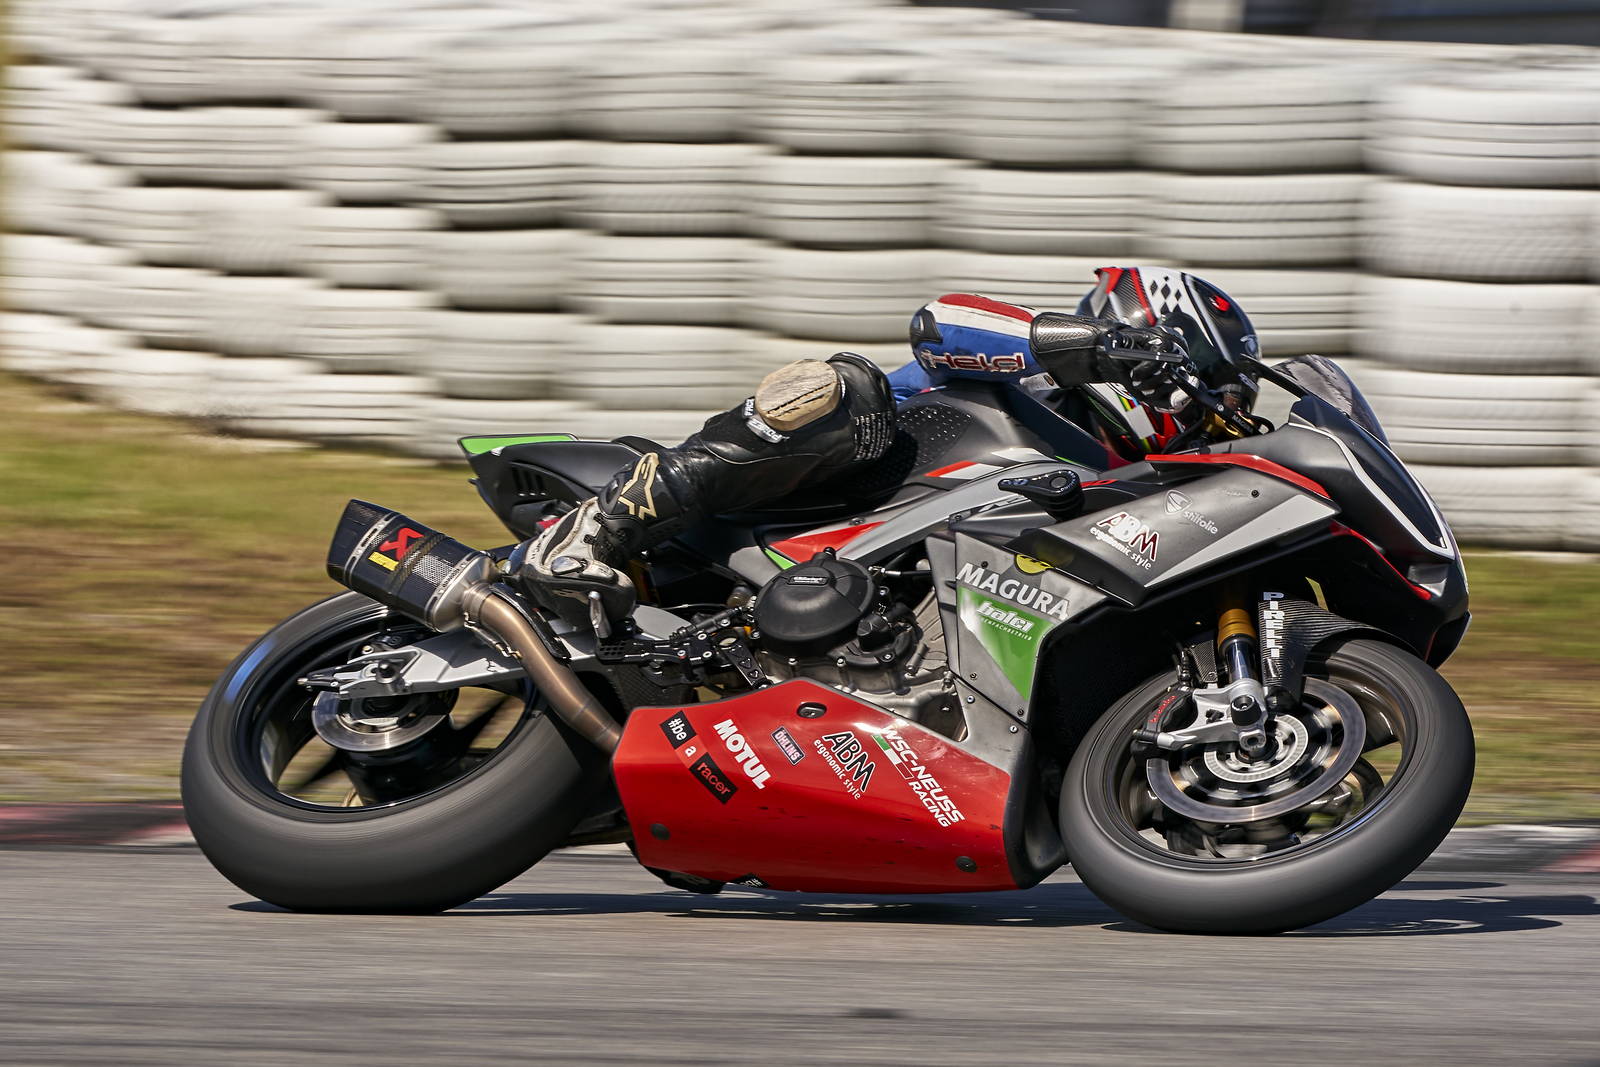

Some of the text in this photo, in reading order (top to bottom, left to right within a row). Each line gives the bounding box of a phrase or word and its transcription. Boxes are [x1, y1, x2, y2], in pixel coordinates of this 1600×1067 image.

[920, 350, 1026, 373] Held
[1090, 527, 1152, 570] ergonomic style
[1097, 511, 1159, 561] ABM
[956, 562, 1070, 620] MAGURA
[668, 718, 687, 741] #be
[684, 745, 697, 757] a
[775, 729, 801, 761] ÖHLINS
[713, 719, 771, 789] MOTUL
[813, 739, 861, 800] ergonomic style
[822, 731, 876, 792] ABM
[696, 762, 731, 795] racer
[909, 781, 951, 828] RACING
